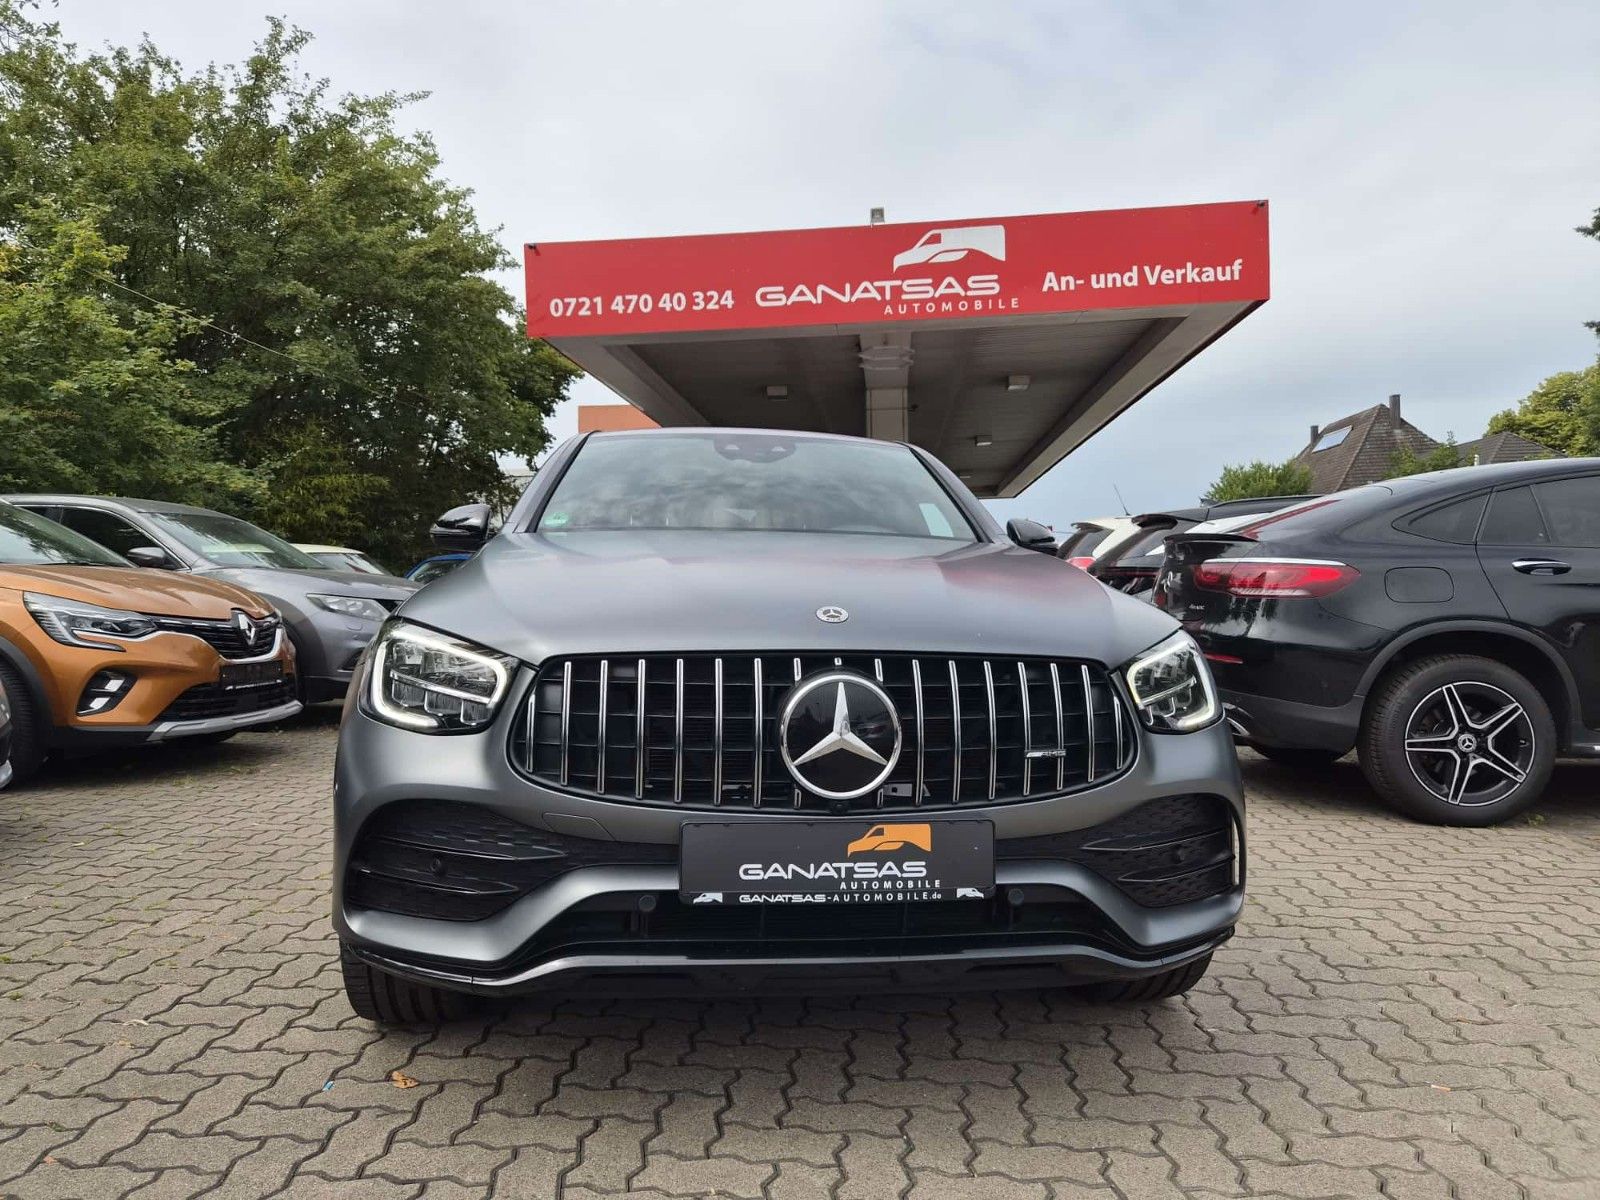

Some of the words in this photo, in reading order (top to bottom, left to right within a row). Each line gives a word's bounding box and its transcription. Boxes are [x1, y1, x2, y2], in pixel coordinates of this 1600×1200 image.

[1041, 270, 1085, 293] An-
[1090, 264, 1139, 290] und
[1143, 258, 1243, 286] Verkauf
[755, 274, 1001, 308] GANATSAS
[549, 295, 603, 318] 0721
[610, 293, 653, 315] 470
[657, 291, 687, 312] 40
[692, 288, 735, 311] 324
[883, 297, 1021, 316] AUTOMOBILE
[738, 860, 927, 881] GANATSAS
[839, 879, 941, 890] AUTOMOBILE
[738, 891, 942, 904] GANATSAS-AUTOMOBILE.de
